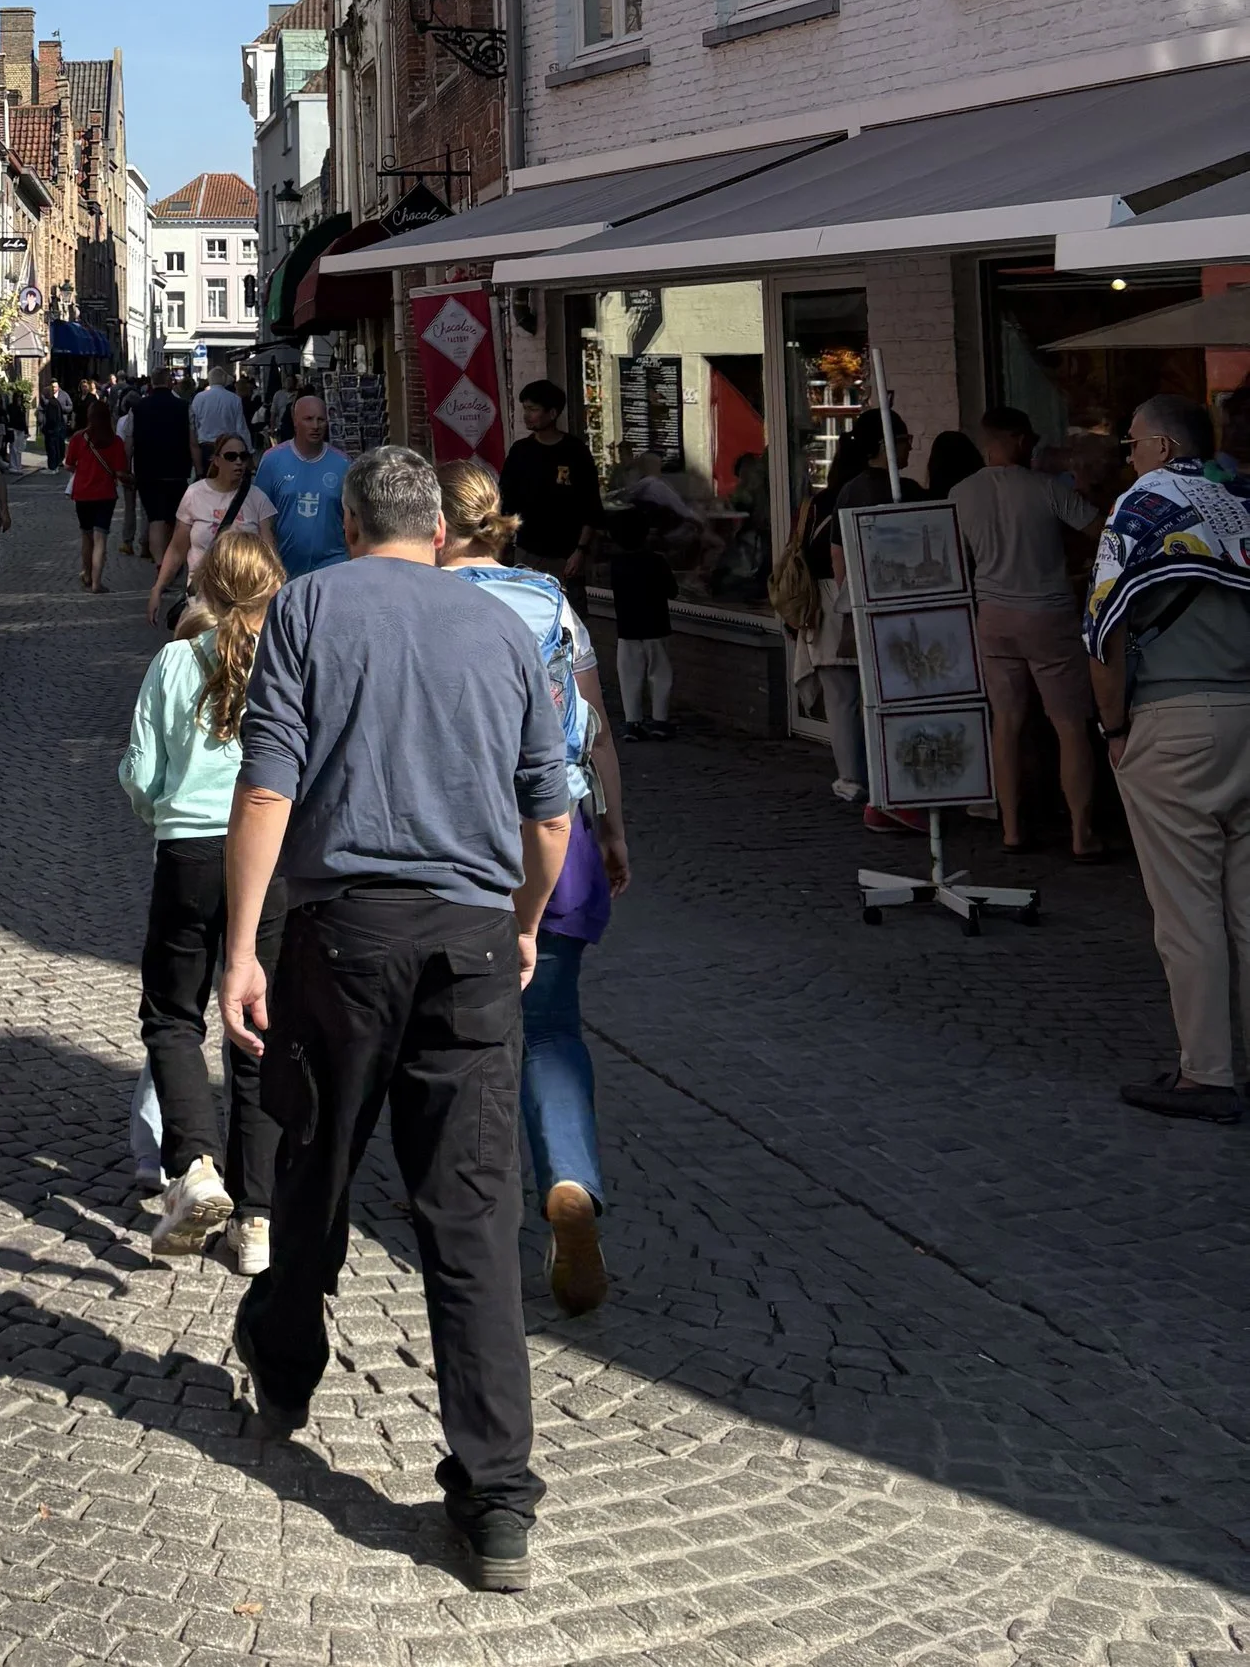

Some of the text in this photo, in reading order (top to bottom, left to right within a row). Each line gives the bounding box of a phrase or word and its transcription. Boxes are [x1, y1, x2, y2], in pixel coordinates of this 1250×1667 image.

[432, 319, 477, 338] Chocolate
[445, 398, 491, 415] Chocolate
[556, 465, 571, 485] R
